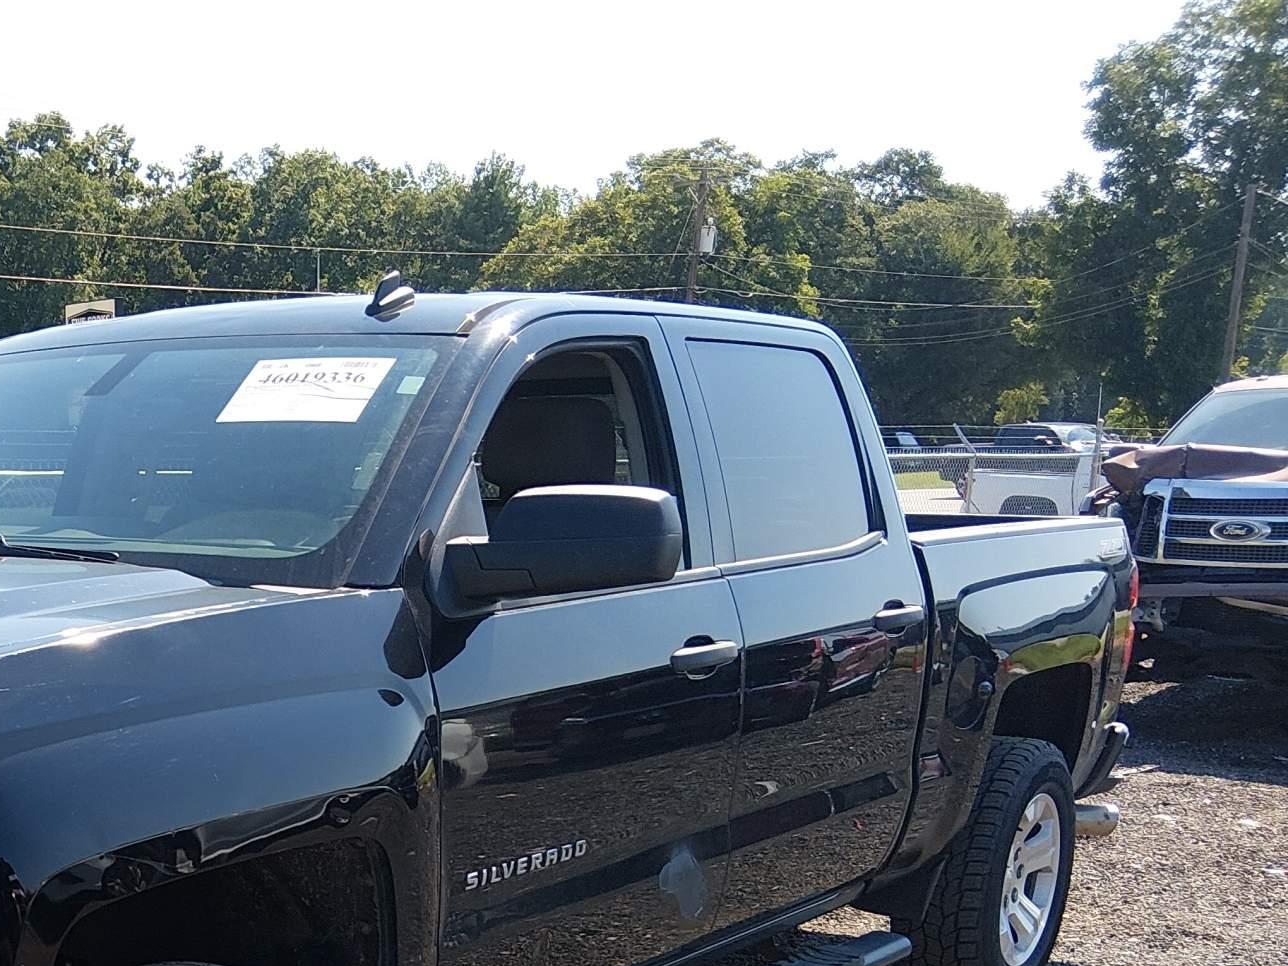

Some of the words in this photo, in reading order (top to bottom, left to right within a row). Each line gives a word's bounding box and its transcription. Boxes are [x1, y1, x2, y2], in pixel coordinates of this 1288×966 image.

[258, 371, 366, 385] 46019336
[1222, 524, 1249, 536] Ford
[464, 839, 587, 891] SILVERADO
